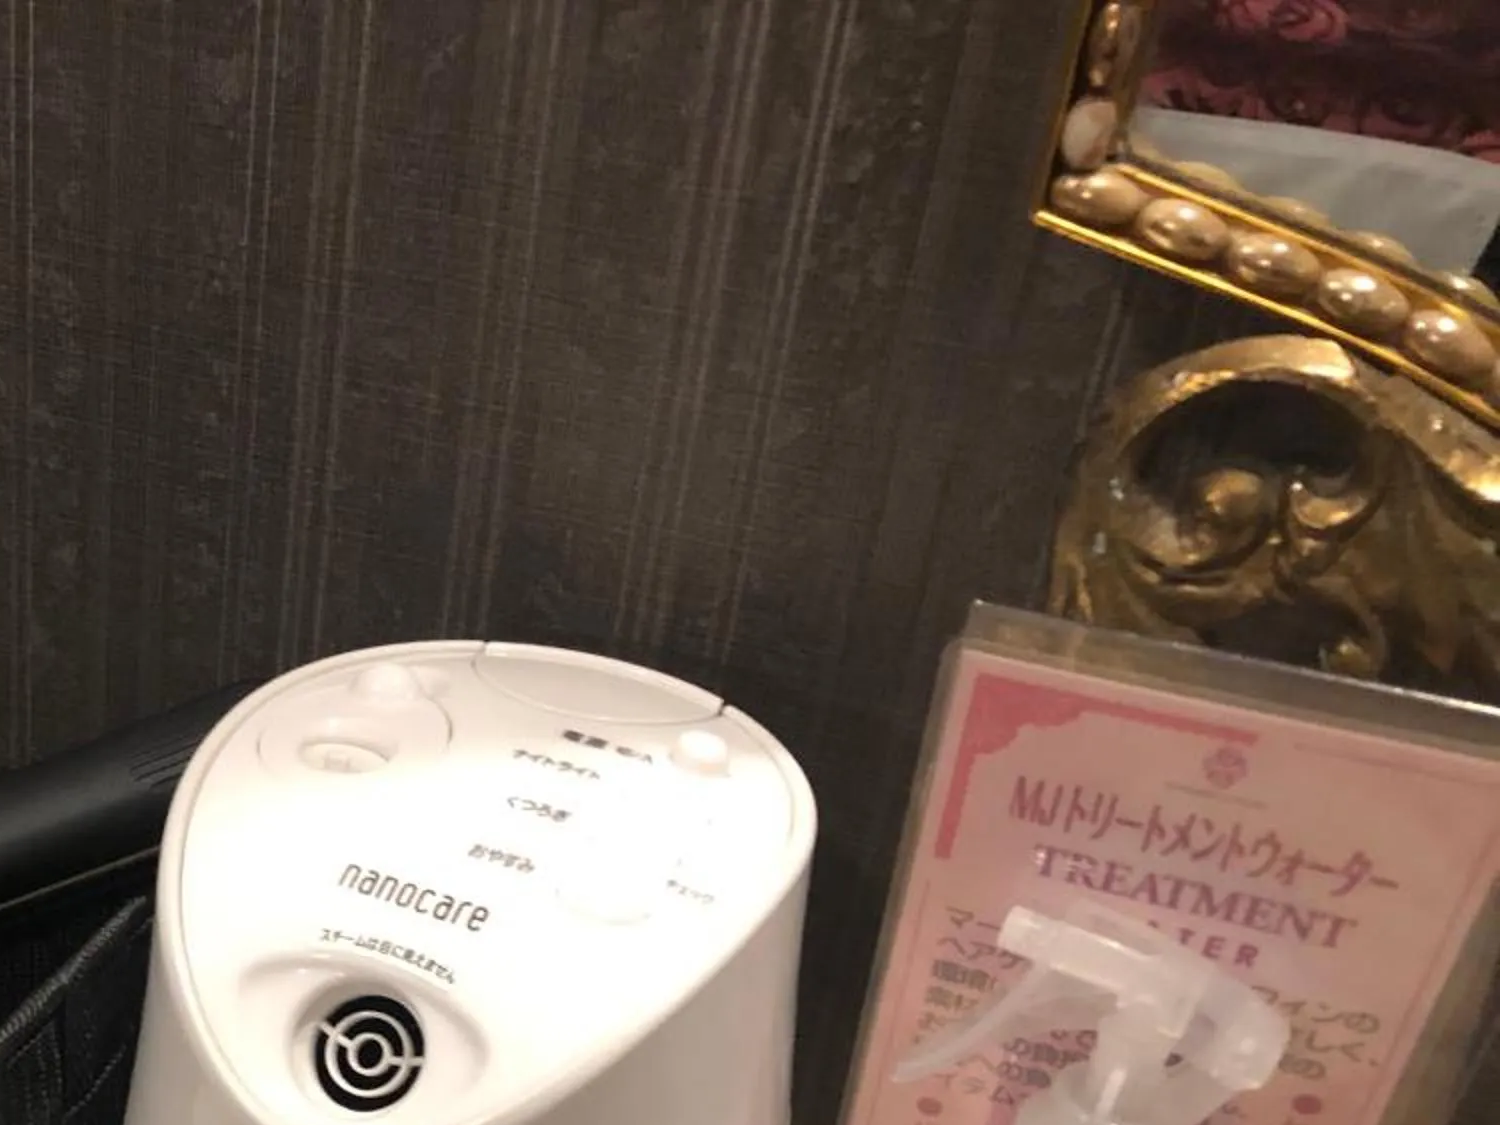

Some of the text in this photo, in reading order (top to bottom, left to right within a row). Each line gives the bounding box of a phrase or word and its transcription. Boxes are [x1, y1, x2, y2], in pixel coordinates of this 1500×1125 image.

[467, 843, 535, 873] おやすみ
[338, 863, 490, 932] nanocare
[1033, 843, 1359, 949] TREATMENT
